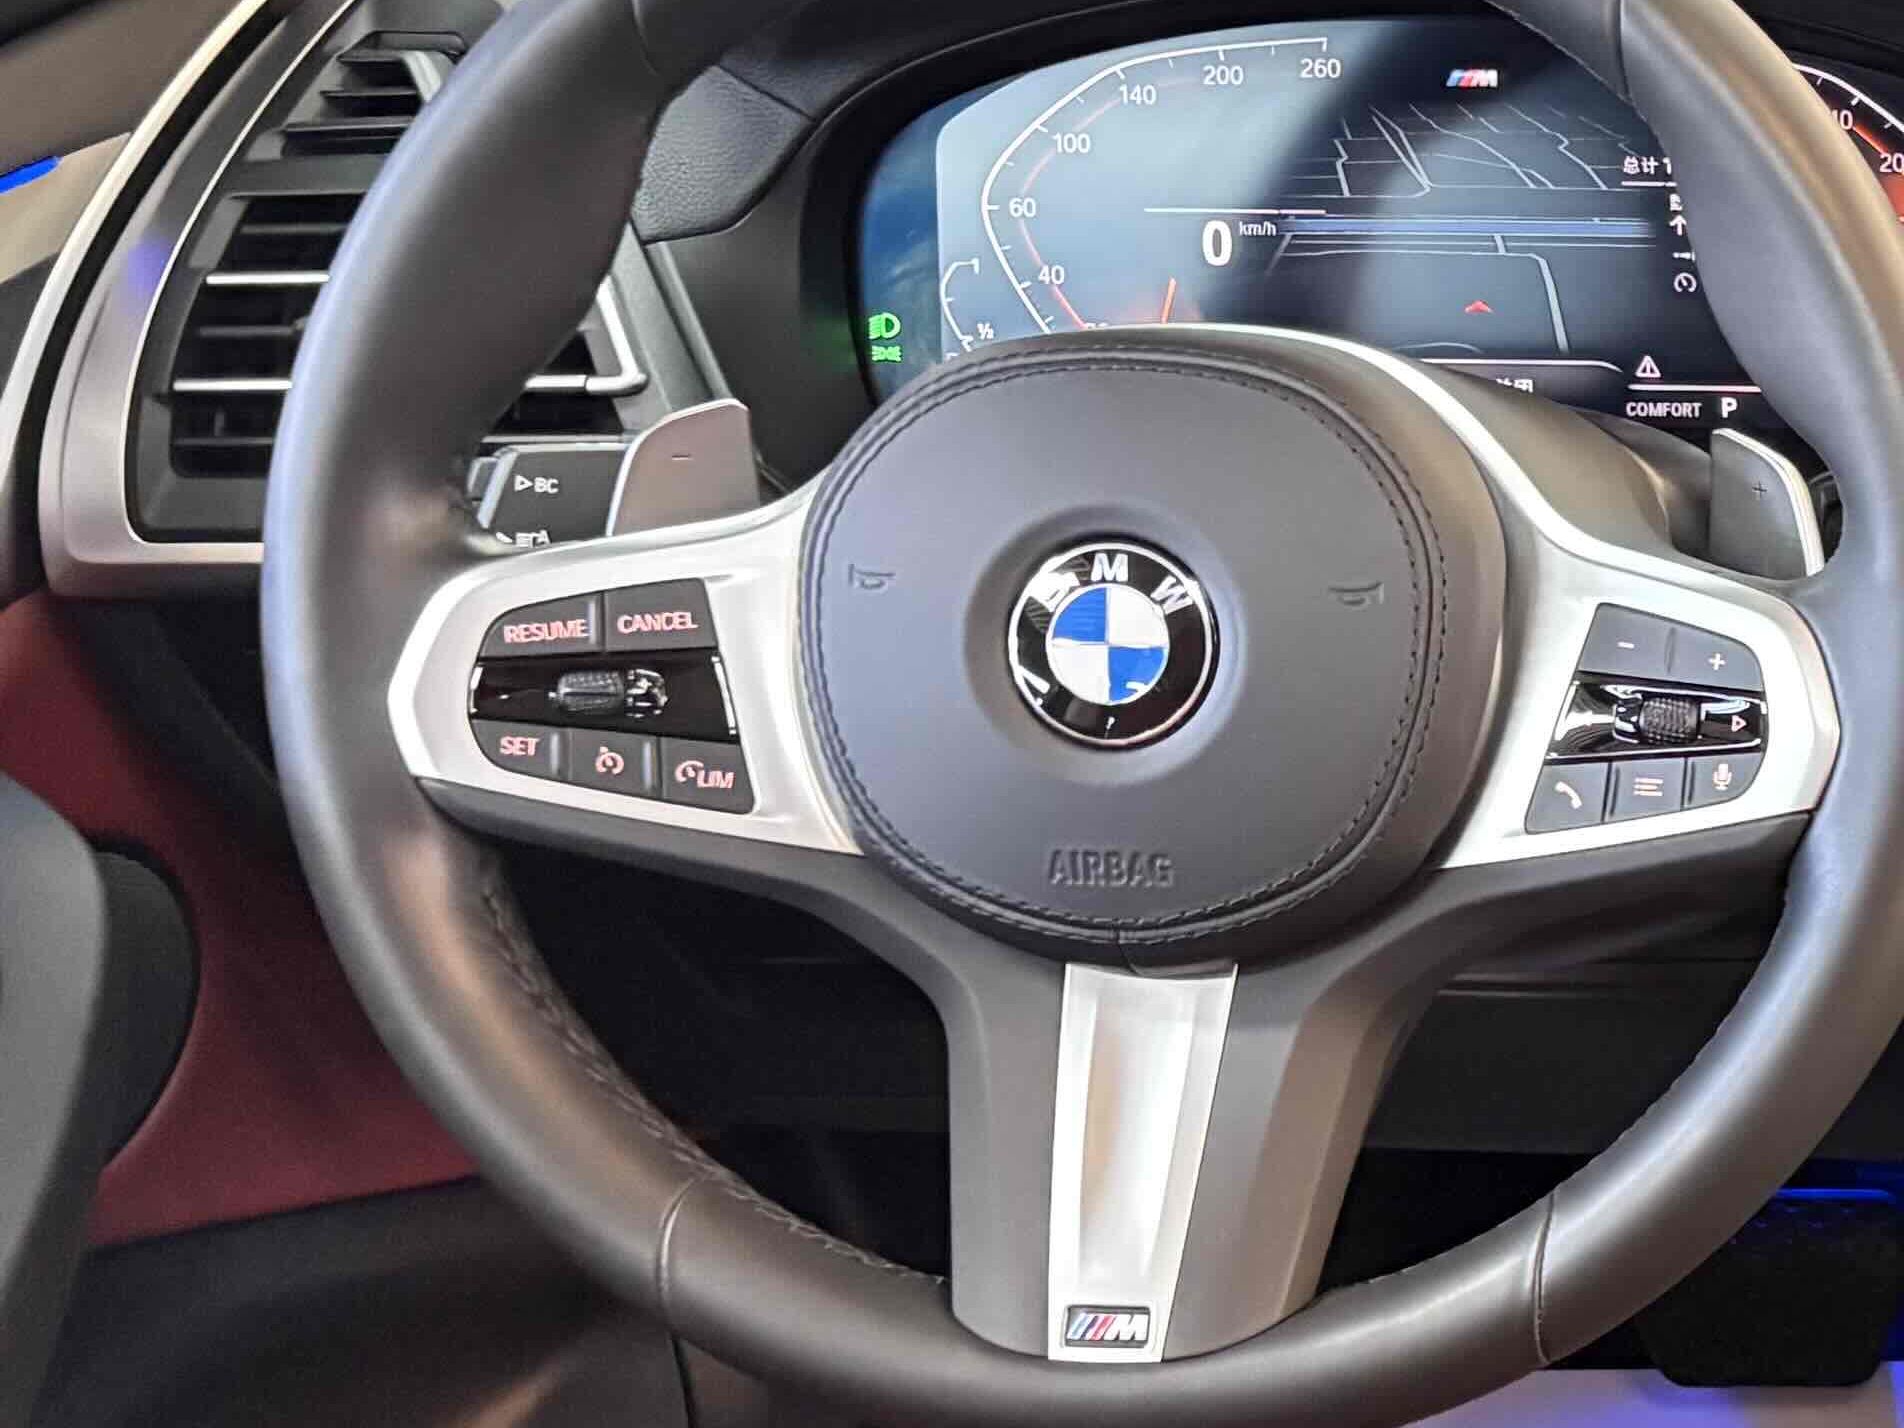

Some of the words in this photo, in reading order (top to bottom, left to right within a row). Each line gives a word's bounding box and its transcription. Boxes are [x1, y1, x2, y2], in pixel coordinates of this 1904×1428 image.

[1203, 65, 1244, 86] 200
[1301, 58, 1342, 79] 260
[1119, 84, 1157, 106] 140
[1053, 133, 1091, 154] 100
[1623, 156, 1658, 174] 总计
[1009, 198, 1036, 218] 60
[1202, 220, 1233, 266] 0
[1239, 219, 1277, 238] km/h
[1038, 265, 1065, 285] 40
[1626, 401, 1702, 418] COMFORT
[1721, 397, 1738, 418] P
[534, 476, 559, 493] BC
[1034, 551, 1195, 614] BMW
[503, 619, 588, 643] RESUME
[617, 611, 698, 635] CANCEL
[500, 737, 540, 756] SET
[698, 769, 735, 789] LIM
[1047, 849, 1173, 887] AIRBAG
